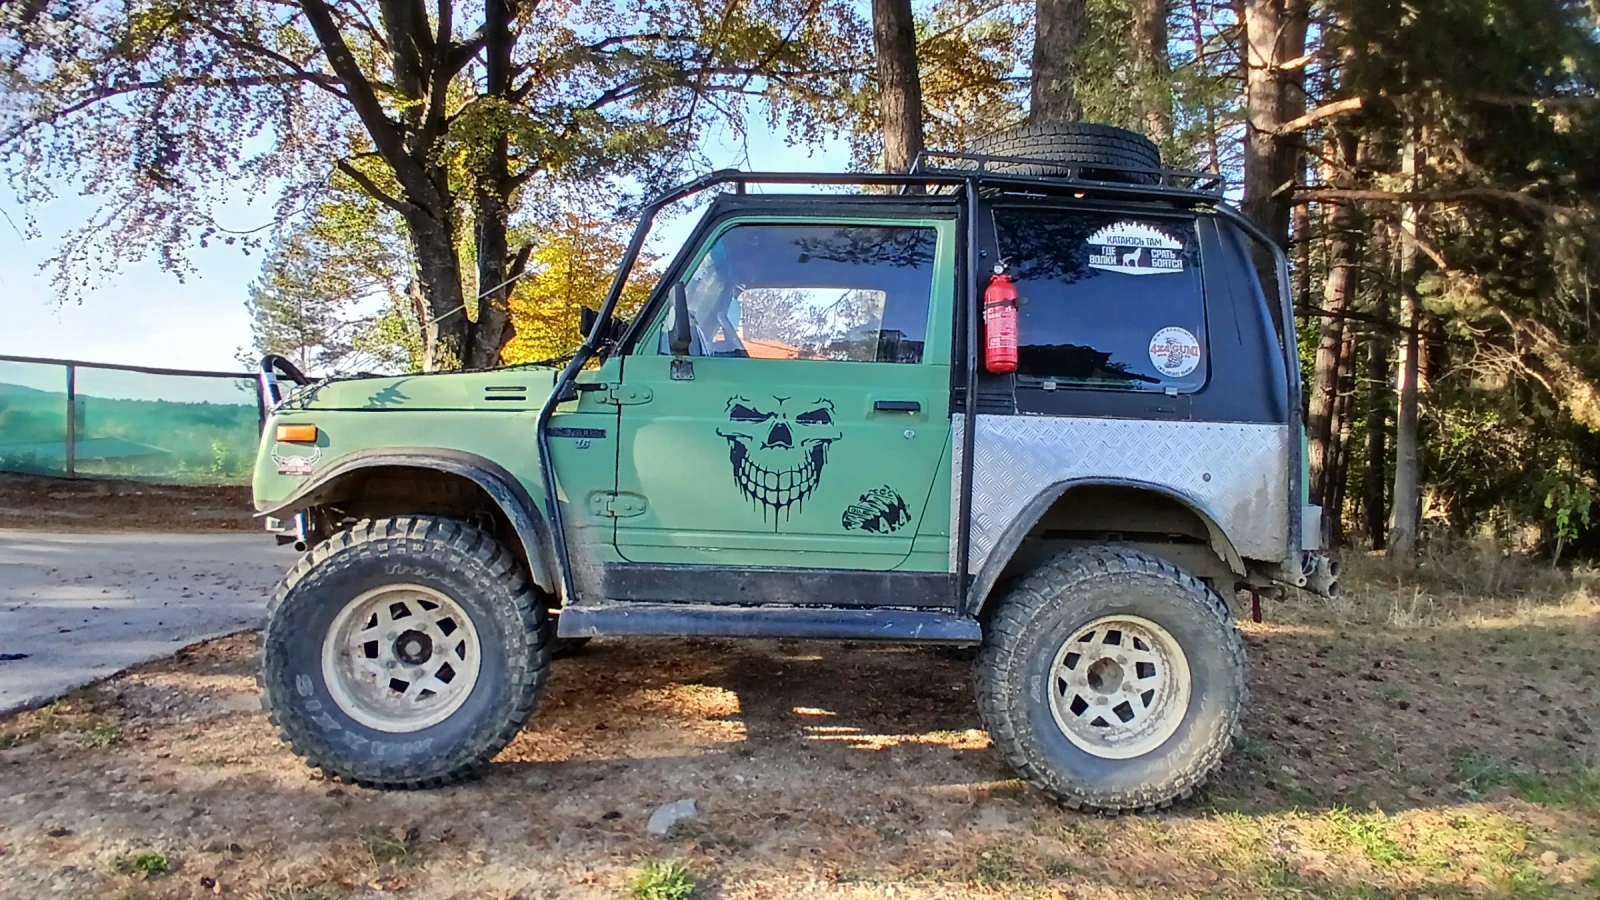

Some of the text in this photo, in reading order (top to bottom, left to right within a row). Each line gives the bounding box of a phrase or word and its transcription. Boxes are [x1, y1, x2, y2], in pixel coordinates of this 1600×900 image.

[1107, 236, 1162, 247] КАТАЮСЬ ТАМ
[1101, 246, 1116, 255] ГДЕ
[1151, 249, 1176, 259] СРАТЬ
[1089, 255, 1117, 265] ВОЛКИ
[1151, 259, 1183, 269] БОЯТСЯ
